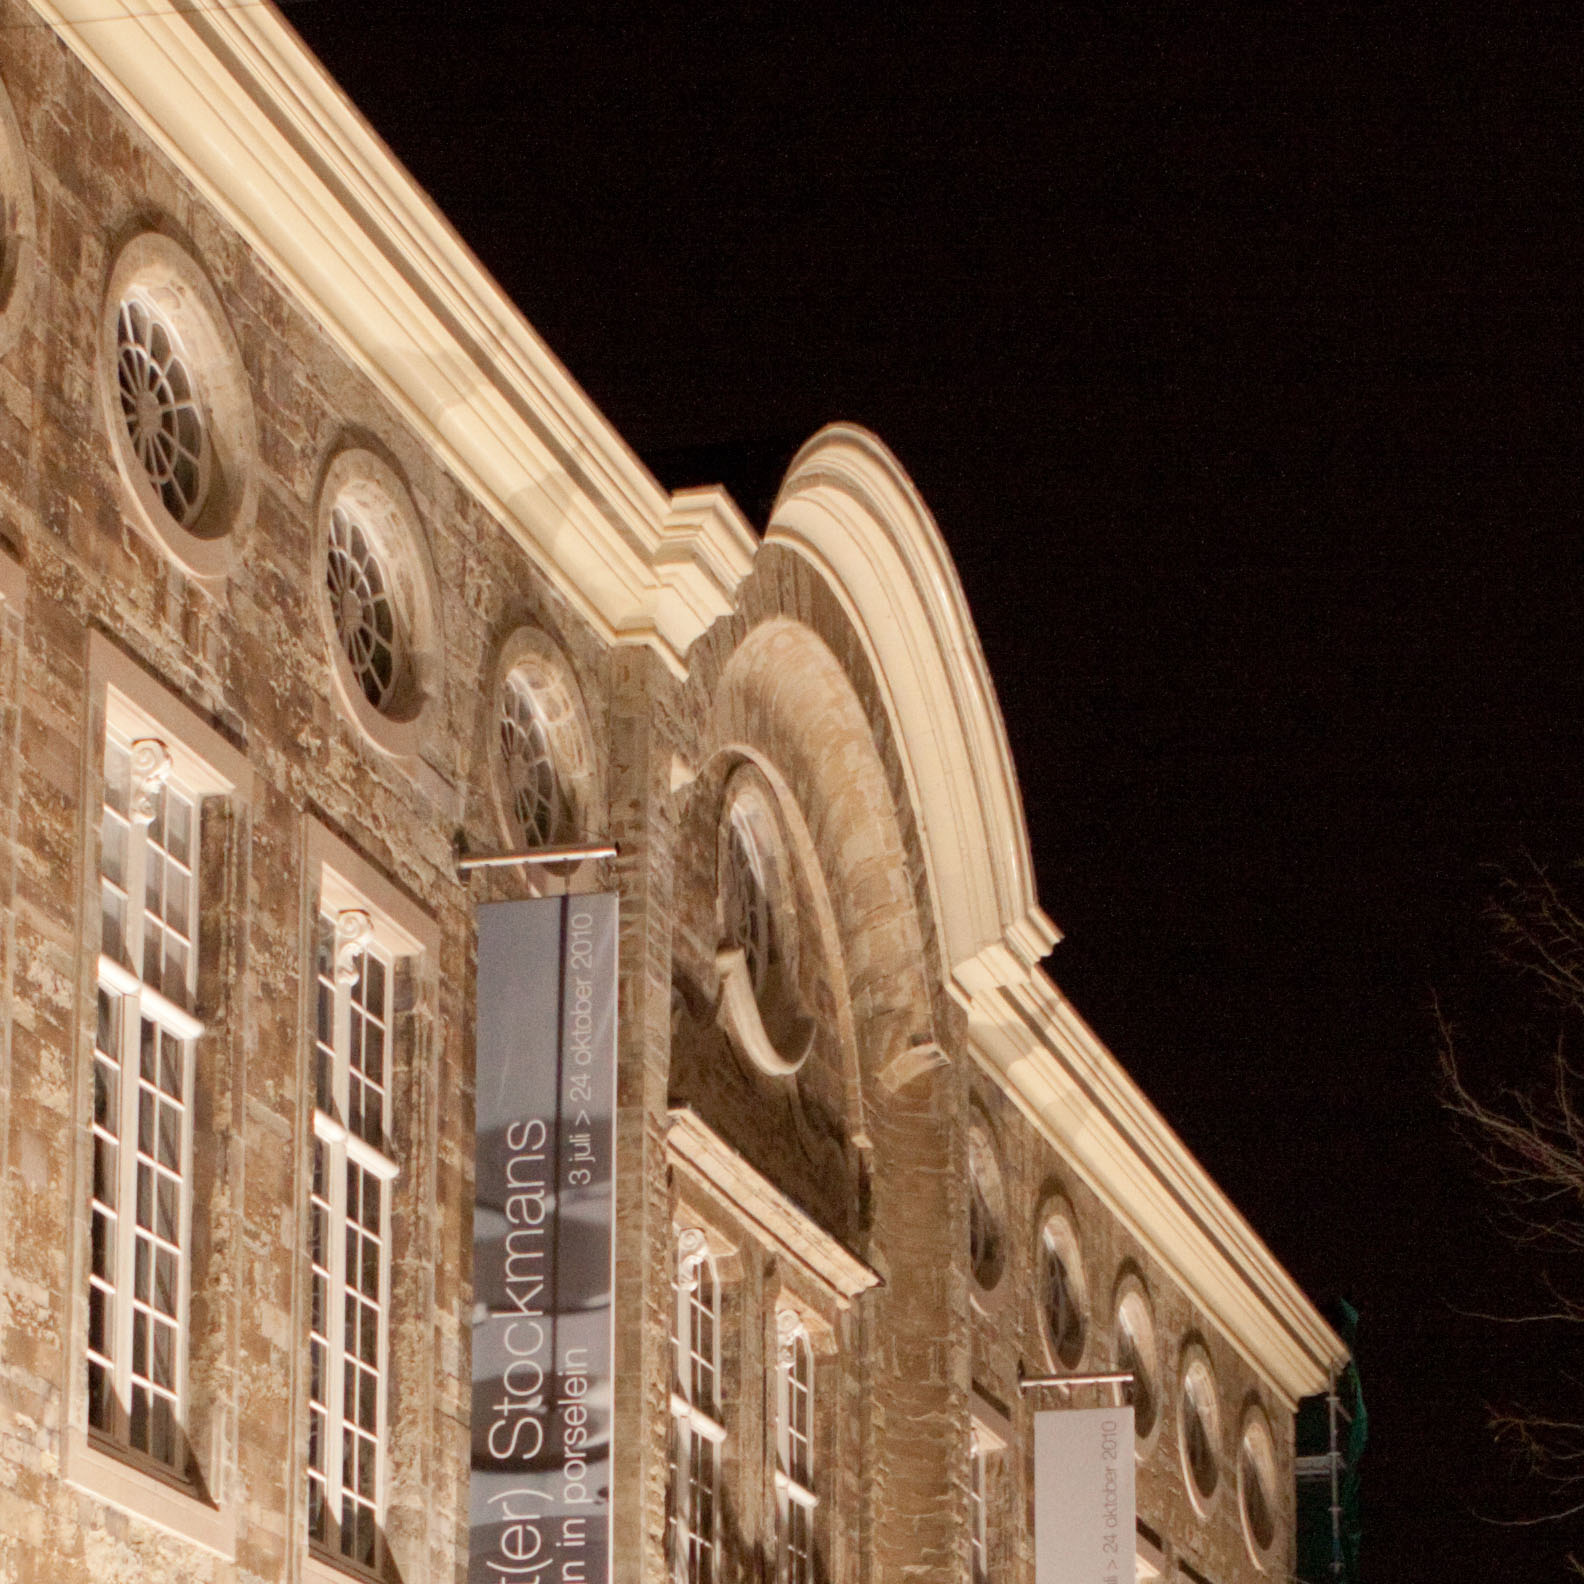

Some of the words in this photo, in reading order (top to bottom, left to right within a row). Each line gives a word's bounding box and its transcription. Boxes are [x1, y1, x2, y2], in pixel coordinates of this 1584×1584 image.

[569, 913, 592, 969] 2010
[568, 977, 593, 1066] oktober
[569, 1074, 591, 1101] 24
[566, 1133, 598, 1162] juli
[569, 1169, 591, 1184] 3
[485, 1119, 548, 1459] Stockmans
[557, 1348, 597, 1503] porselein
[1101, 1421, 1119, 1461] 2010
[1102, 1467, 1119, 1528] oktober
[555, 1518, 587, 1548] in
[1103, 1534, 1119, 1553] 24
